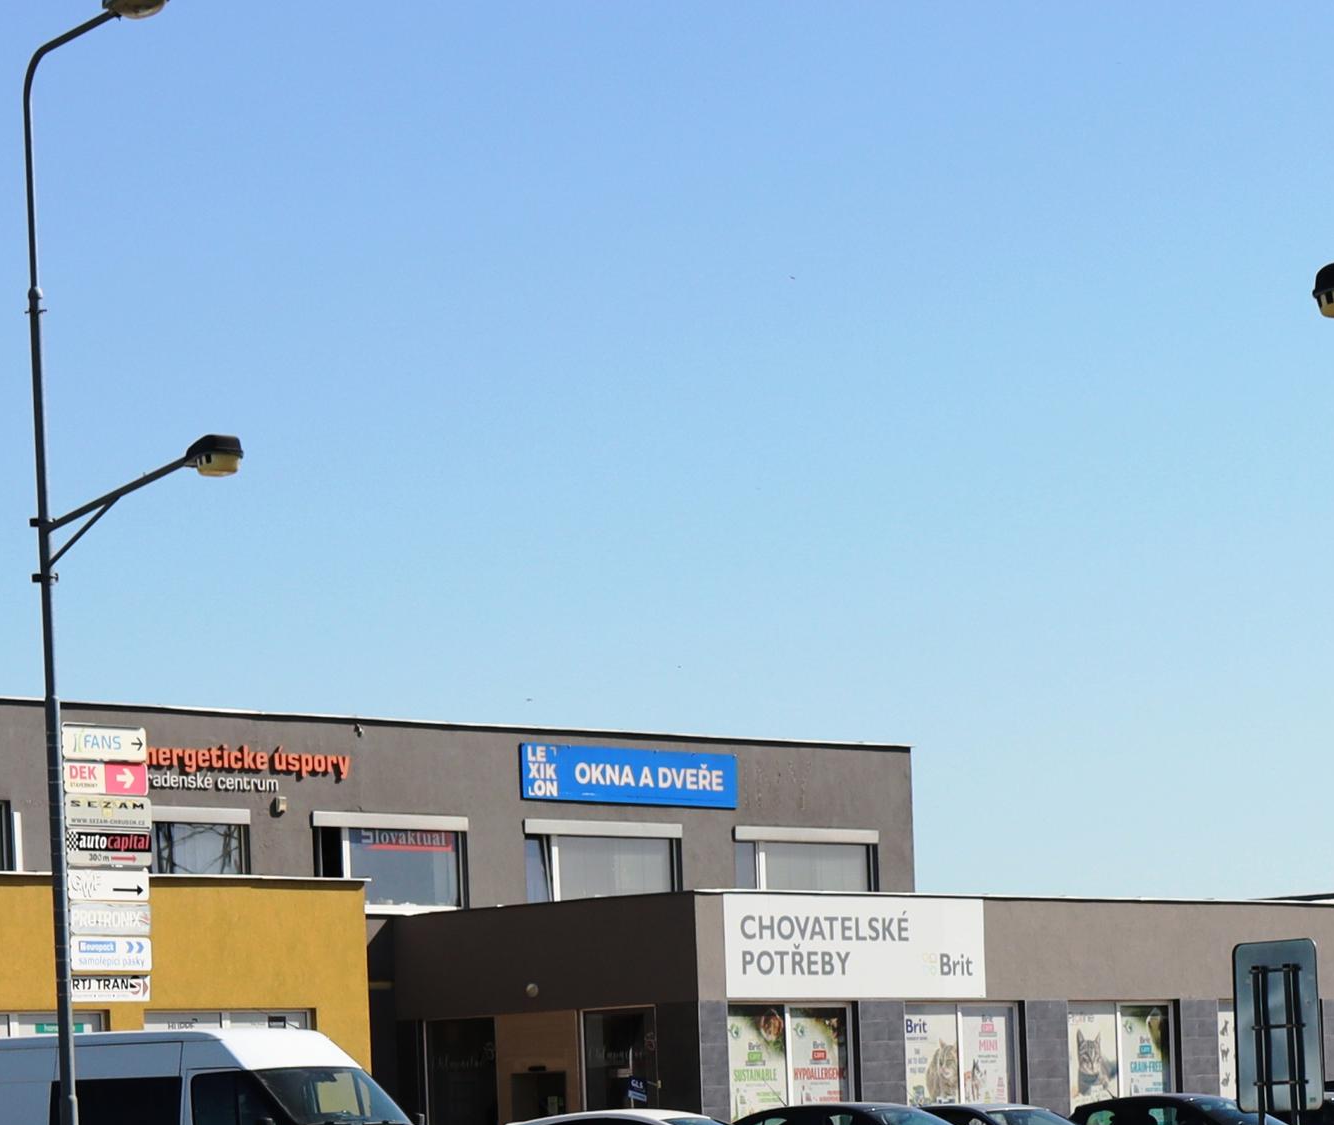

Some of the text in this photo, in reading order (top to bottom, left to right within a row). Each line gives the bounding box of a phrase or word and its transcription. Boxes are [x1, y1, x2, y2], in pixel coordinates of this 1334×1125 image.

[83, 734, 122, 750] FANS
[274, 745, 351, 779] úspory
[527, 745, 547, 762] LE
[69, 764, 97, 780] DEK
[528, 762, 557, 779] XIK
[574, 762, 724, 792] OKNA A DVEŘE
[217, 776, 279, 792] centrum
[533, 779, 558, 797] ON
[70, 800, 145, 810] SEZAM
[78, 833, 150, 851] autocapital
[739, 910, 910, 942] CHOVATELSKÉ
[741, 943, 851, 976] POTŘEBY
[939, 952, 973, 977] Brit
[72, 978, 91, 990] RTJ
[906, 1018, 928, 1034] Brit
